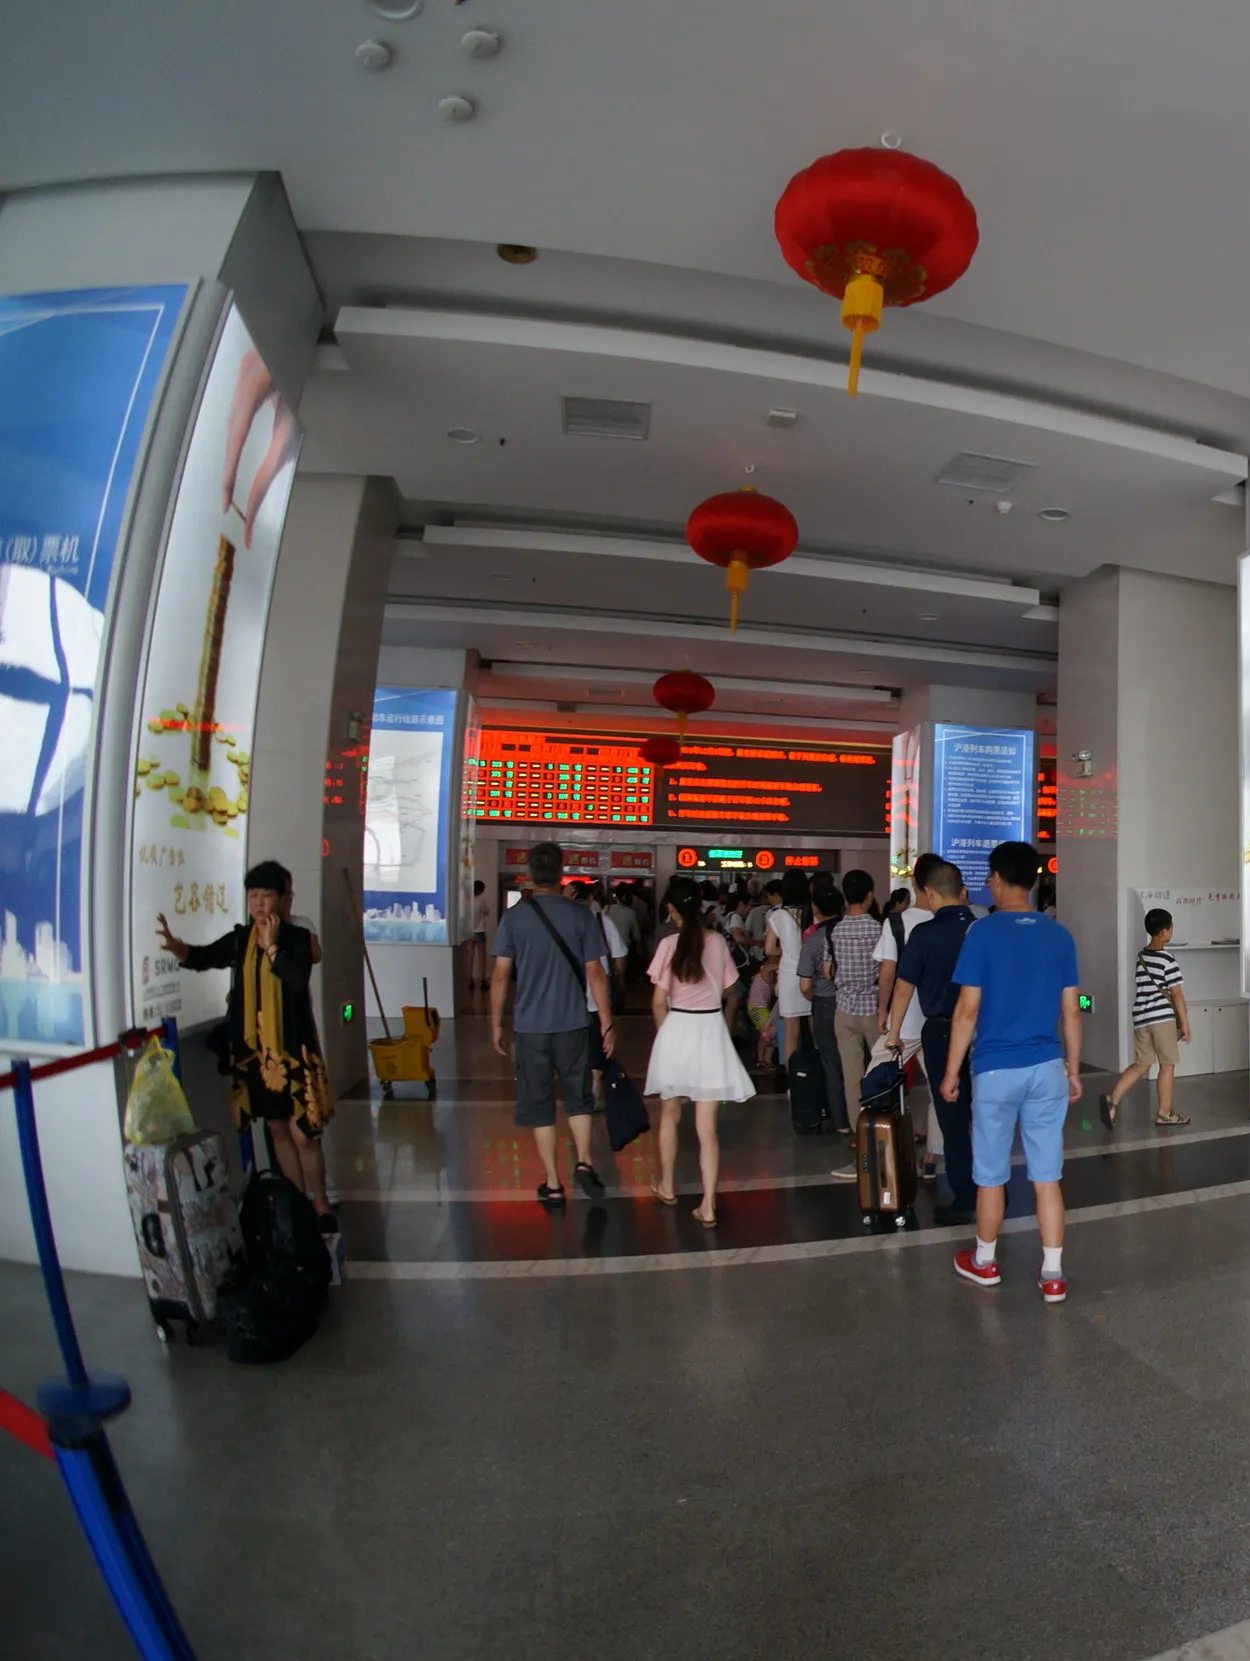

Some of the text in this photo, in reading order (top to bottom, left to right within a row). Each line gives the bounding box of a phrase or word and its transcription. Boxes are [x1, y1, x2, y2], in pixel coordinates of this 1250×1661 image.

[0, 534, 80, 565] (取)票机
[953, 743, 1017, 756] 沪港列车购票须知
[951, 837, 1006, 849] 沪港列车退票
